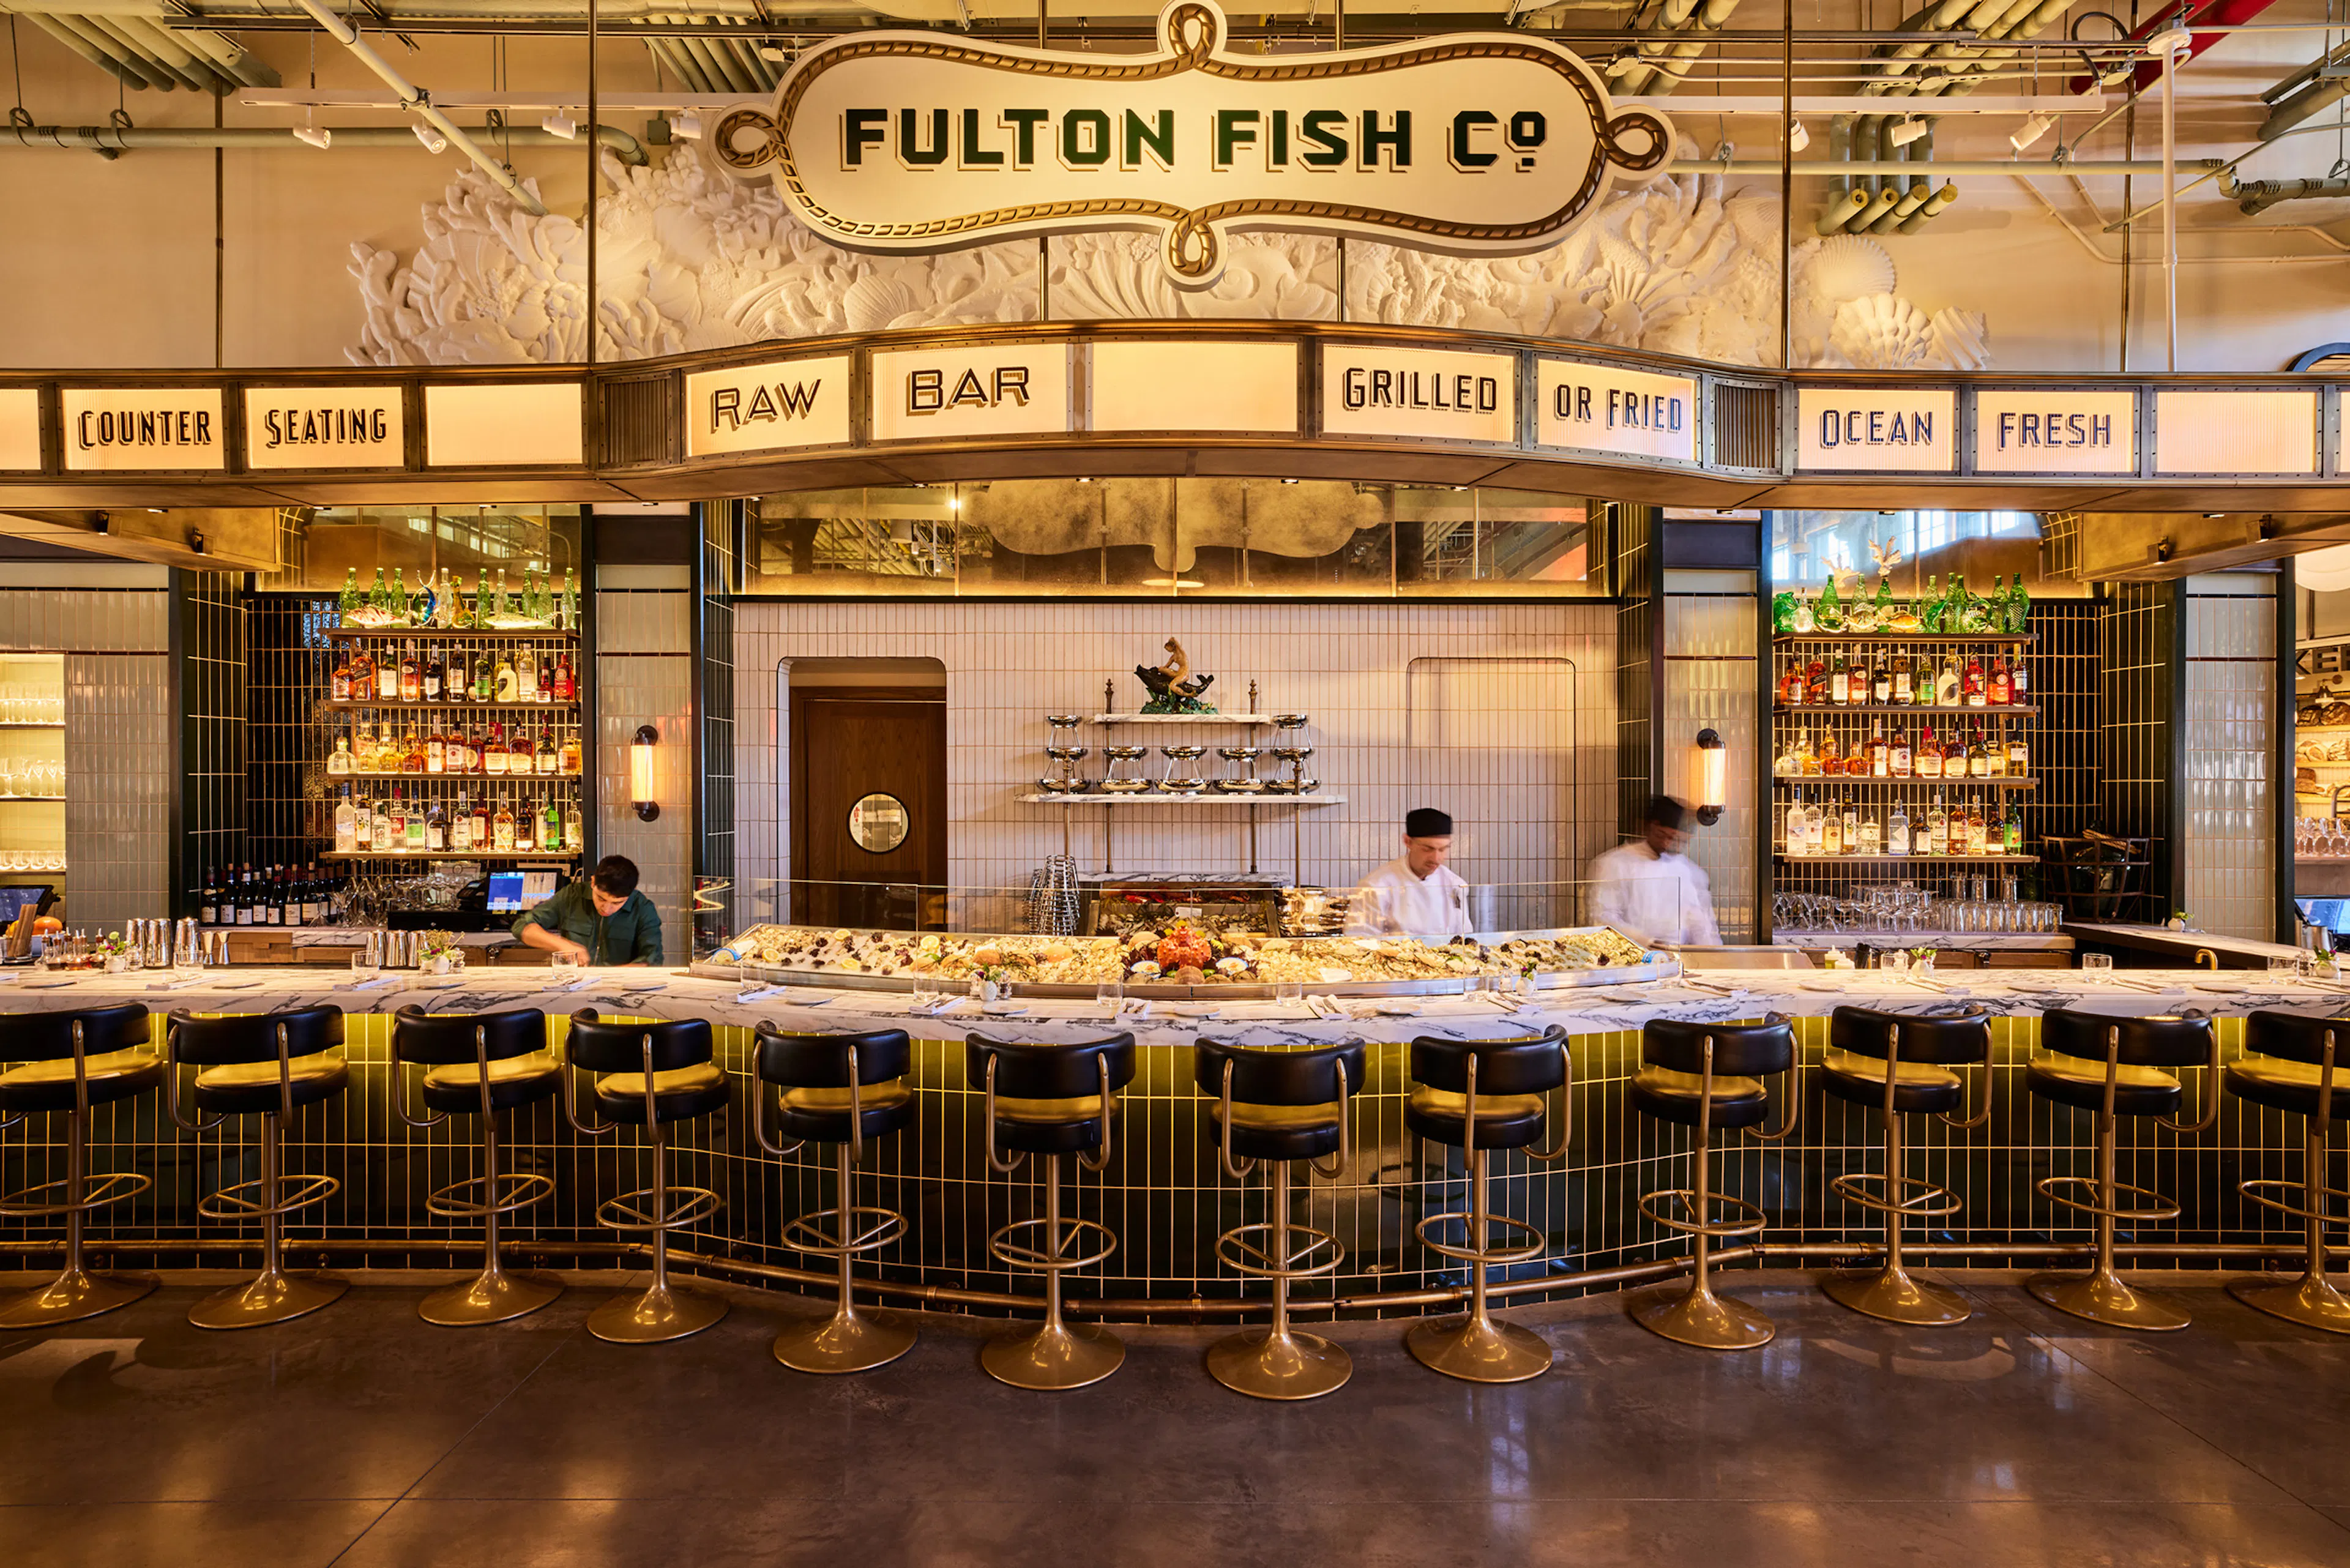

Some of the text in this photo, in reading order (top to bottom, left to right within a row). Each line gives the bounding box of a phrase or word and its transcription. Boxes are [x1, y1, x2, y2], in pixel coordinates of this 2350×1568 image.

[840, 108, 1174, 172] FULTON
[1211, 110, 1412, 173] FISH
[78, 408, 387, 450] COUNTER SEATING
[711, 366, 1030, 434] RAW BAR
[1342, 367, 1682, 433] GRILLED OR FRIED
[1819, 409, 2111, 452] OCEAN FRESH
